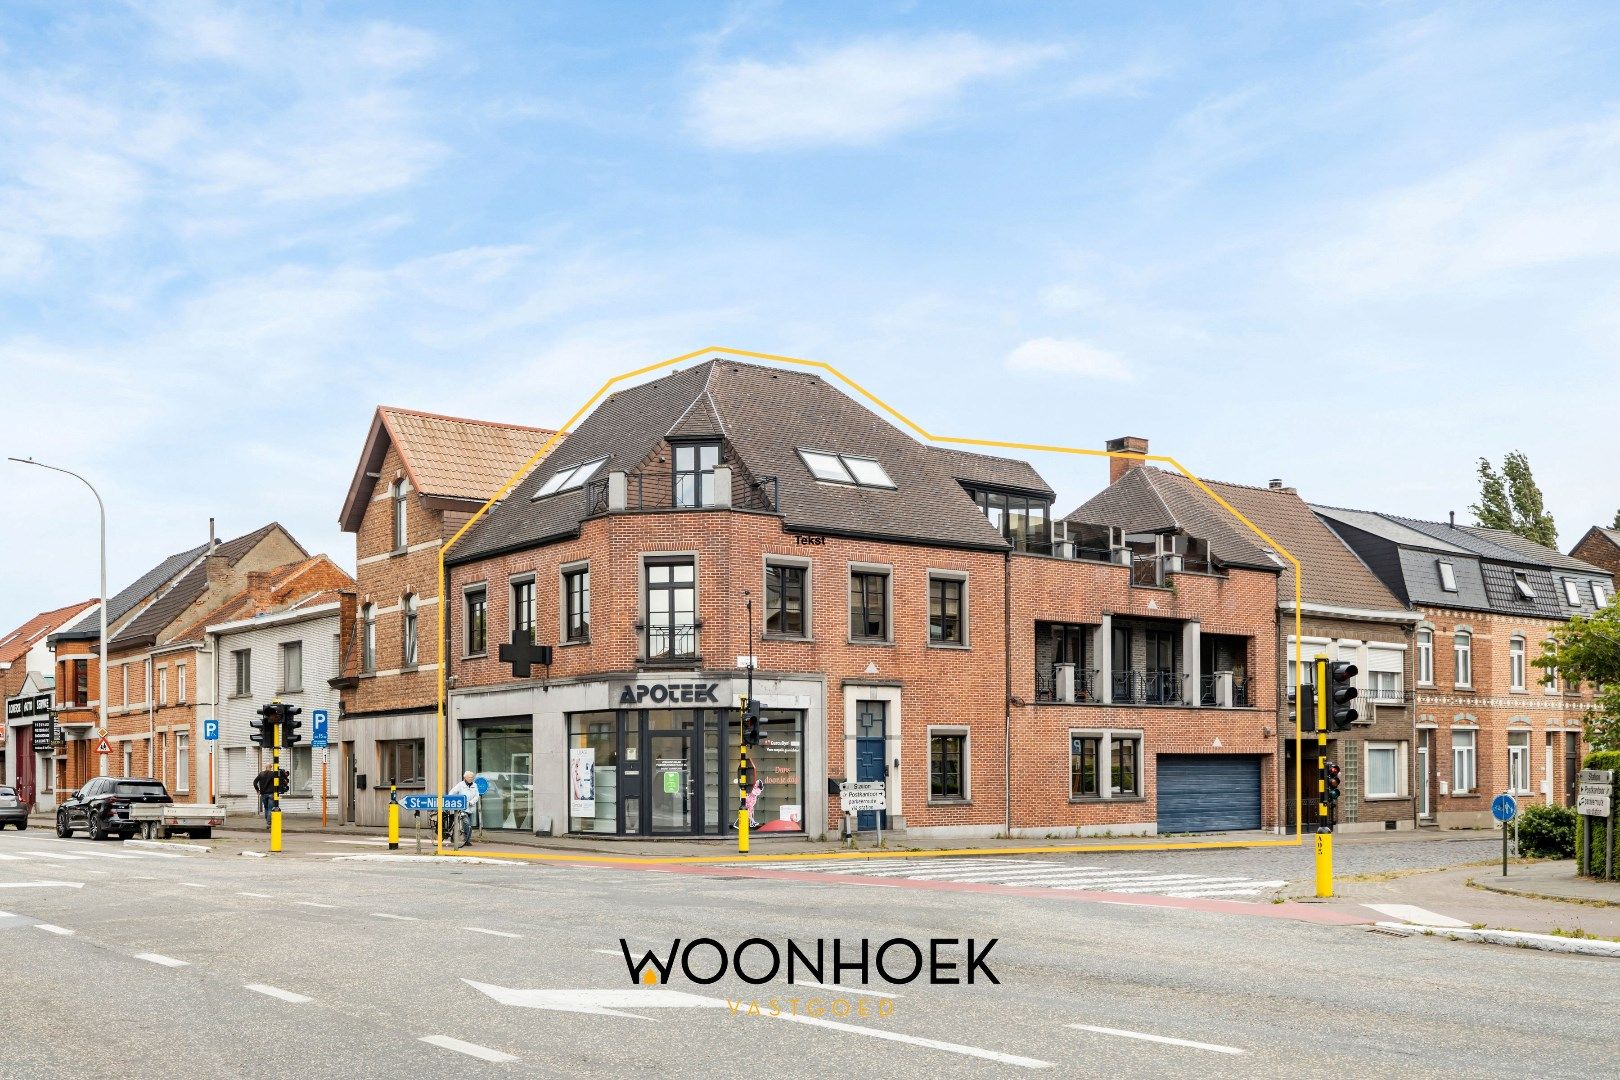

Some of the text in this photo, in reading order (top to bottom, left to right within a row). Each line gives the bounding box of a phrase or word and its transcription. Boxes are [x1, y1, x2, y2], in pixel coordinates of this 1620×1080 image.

[620, 683, 719, 704] APOTEEK
[315, 713, 326, 729] P
[206, 723, 217, 736] P
[410, 797, 462, 808] St-Nilaas
